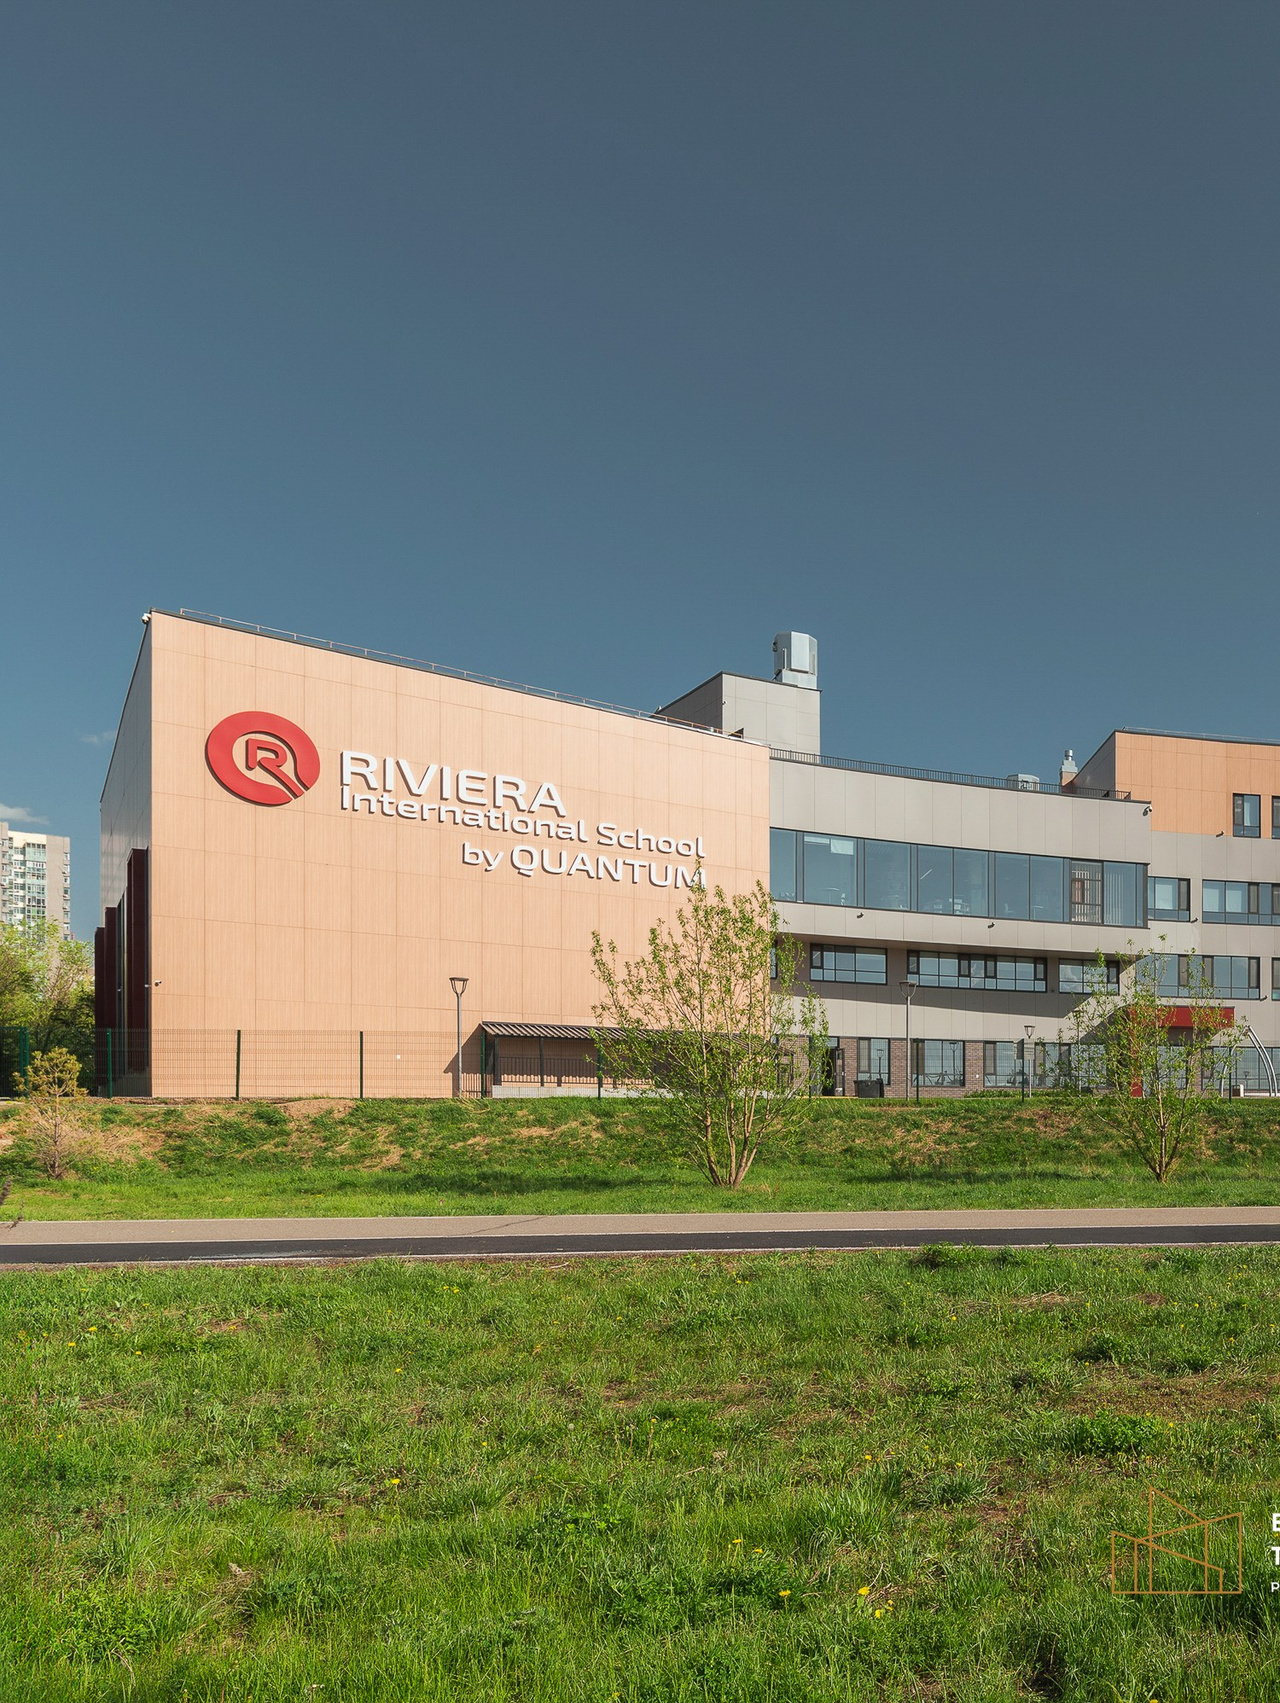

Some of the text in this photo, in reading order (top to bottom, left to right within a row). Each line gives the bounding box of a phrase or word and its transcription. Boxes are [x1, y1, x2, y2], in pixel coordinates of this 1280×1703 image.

[341, 751, 566, 816] RIVIERA
[341, 787, 706, 857] International School
[462, 842, 706, 889] by QUANTUM
